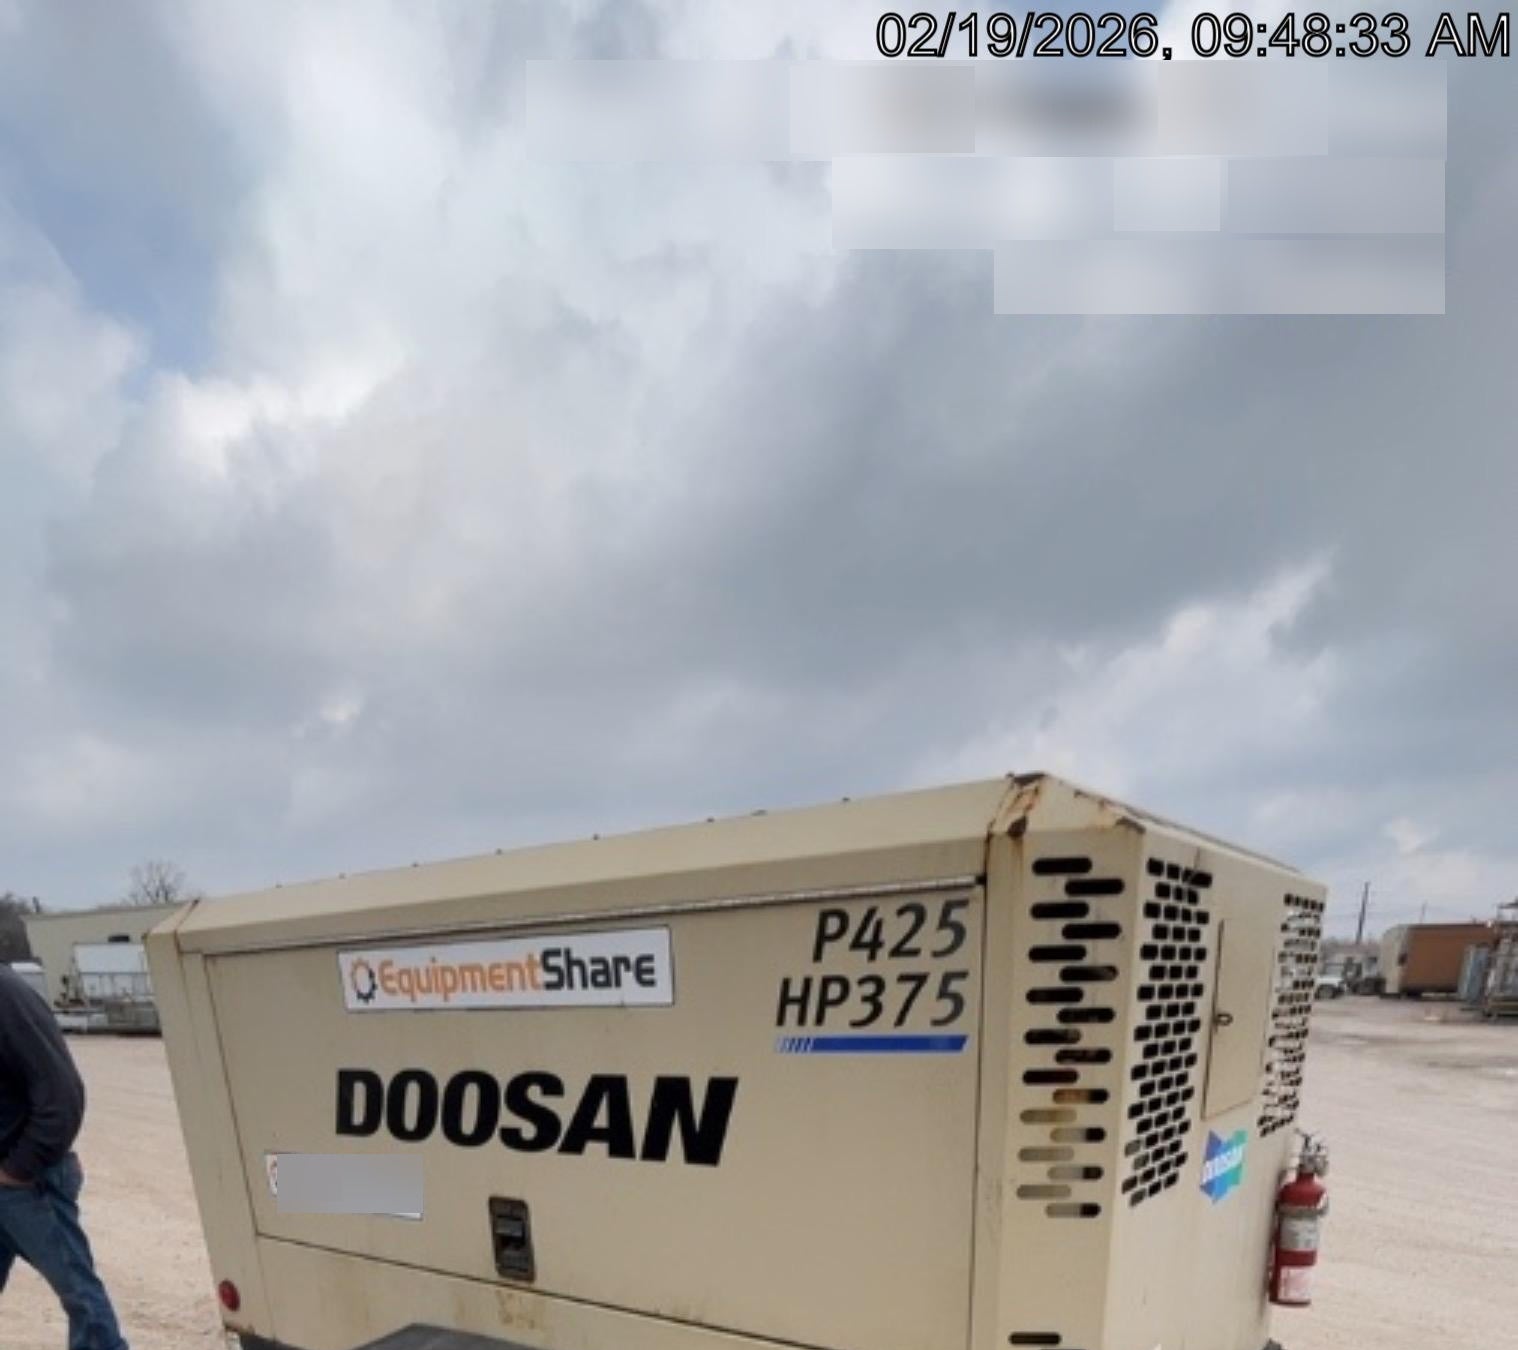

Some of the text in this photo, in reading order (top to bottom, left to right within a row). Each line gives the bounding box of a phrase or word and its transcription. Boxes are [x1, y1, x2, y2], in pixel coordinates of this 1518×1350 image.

[812, 899, 970, 963] P425
[379, 948, 656, 1001] EquipmentShare
[776, 970, 969, 1028] HP375
[336, 1068, 739, 1167] DOOSAN
